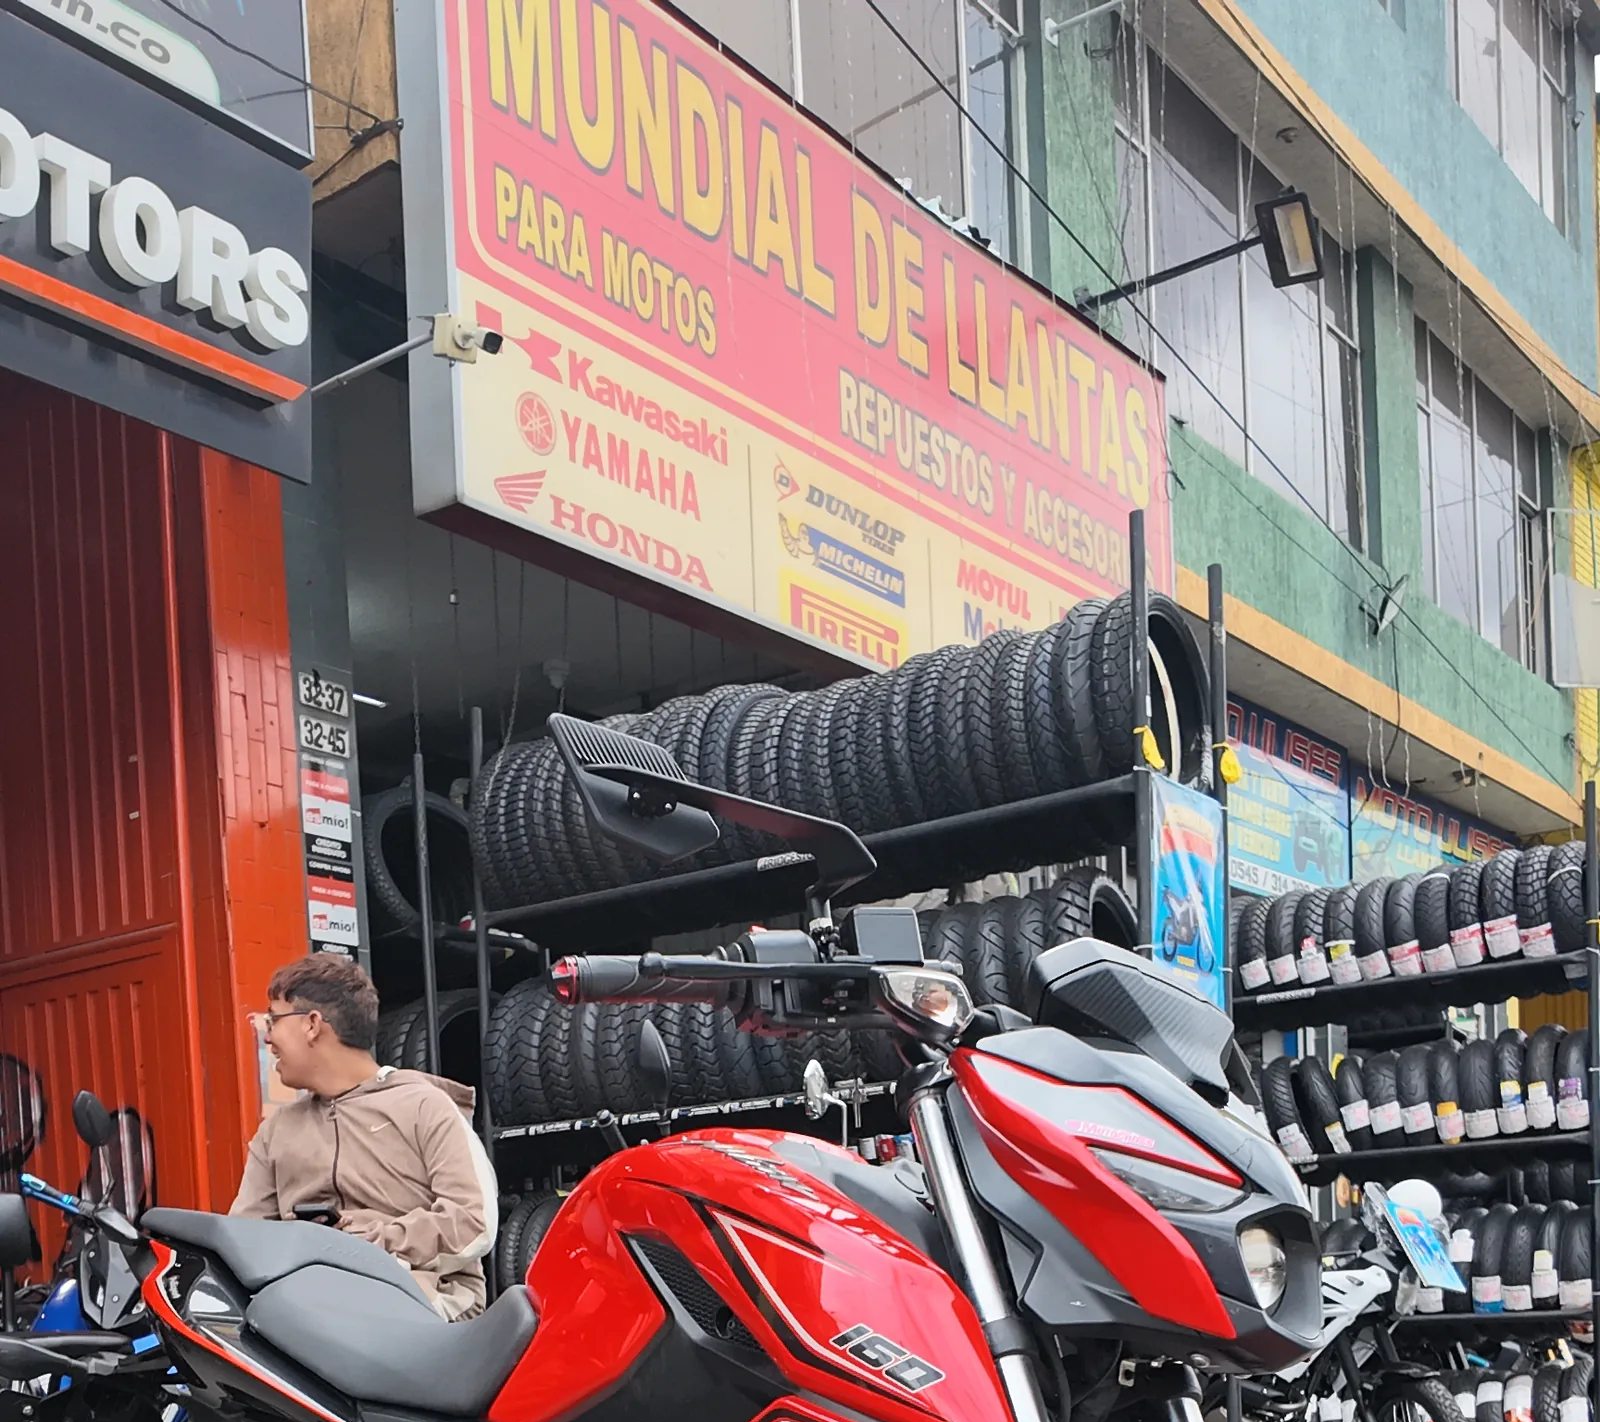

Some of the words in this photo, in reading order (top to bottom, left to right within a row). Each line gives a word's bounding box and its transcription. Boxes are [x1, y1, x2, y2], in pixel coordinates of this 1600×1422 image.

[485, 0, 837, 321] MUNDIAL
[851, 184, 930, 379] DE
[942, 252, 1150, 510] LLANTAS
[494, 162, 595, 292] PARA
[601, 227, 718, 360] MOTOS
[568, 348, 729, 467] Kawasaki
[560, 409, 702, 522] YAMAHA
[838, 366, 995, 518] REPUESTOS
[999, 463, 1017, 528] Y
[1023, 479, 1156, 590] ACCESORI
[548, 493, 714, 593] HONDA
[805, 484, 906, 548] DUNLOP
[862, 532, 896, 556] TIRES
[818, 541, 903, 595] MICHELIN
[957, 558, 1032, 621] MOTUL
[789, 582, 900, 670] PIRELLI
[303, 677, 344, 713] 32-37
[304, 720, 346, 754] 32-45
[1248, 711, 1341, 794] ULISES
[1356, 776, 1432, 845] MOTO
[829, 1323, 946, 1393] 160
